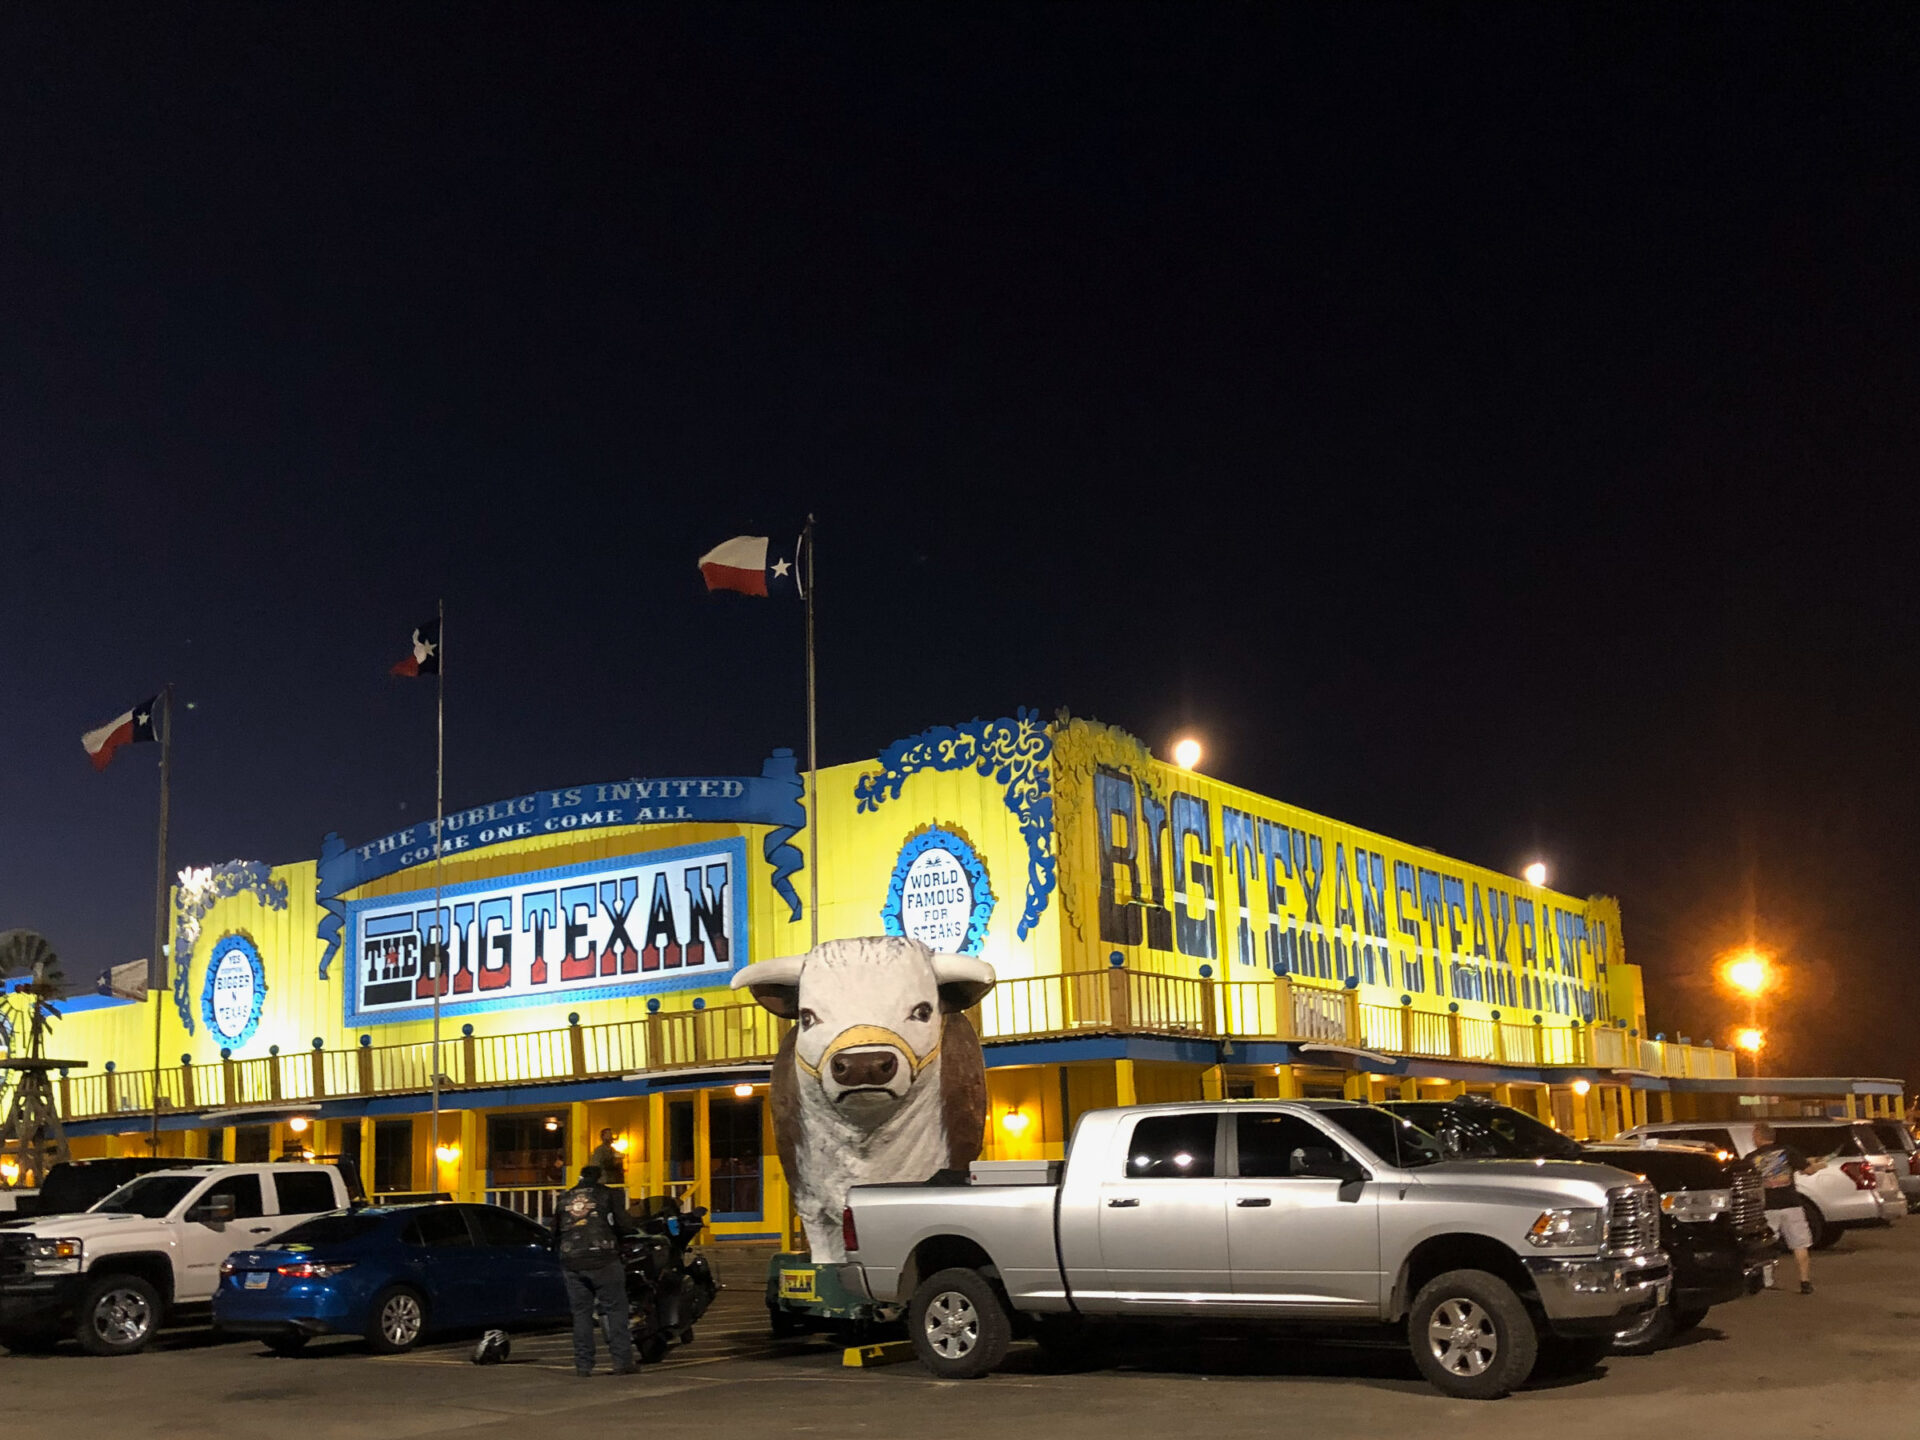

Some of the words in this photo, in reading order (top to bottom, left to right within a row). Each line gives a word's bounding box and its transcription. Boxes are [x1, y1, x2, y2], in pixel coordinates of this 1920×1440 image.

[358, 829, 416, 861] THE
[428, 796, 535, 839] PUBLIC
[552, 791, 582, 807] IS
[598, 780, 745, 801] INVITED
[400, 834, 470, 866] COME
[479, 821, 532, 843] ONE
[545, 808, 623, 831] COME
[635, 805, 693, 820] ALL
[907, 888, 965, 909] FAMOUS
[911, 870, 958, 889] WORLD
[1094, 765, 1217, 960] BIG
[1222, 804, 1393, 988] TEXAN
[1394, 859, 1518, 1007] STEAK
[364, 934, 417, 982] THE
[416, 896, 512, 998] BIG
[522, 863, 728, 984] TEXAN
[913, 922, 962, 941] STEAKS
[924, 908, 949, 921] FOR
